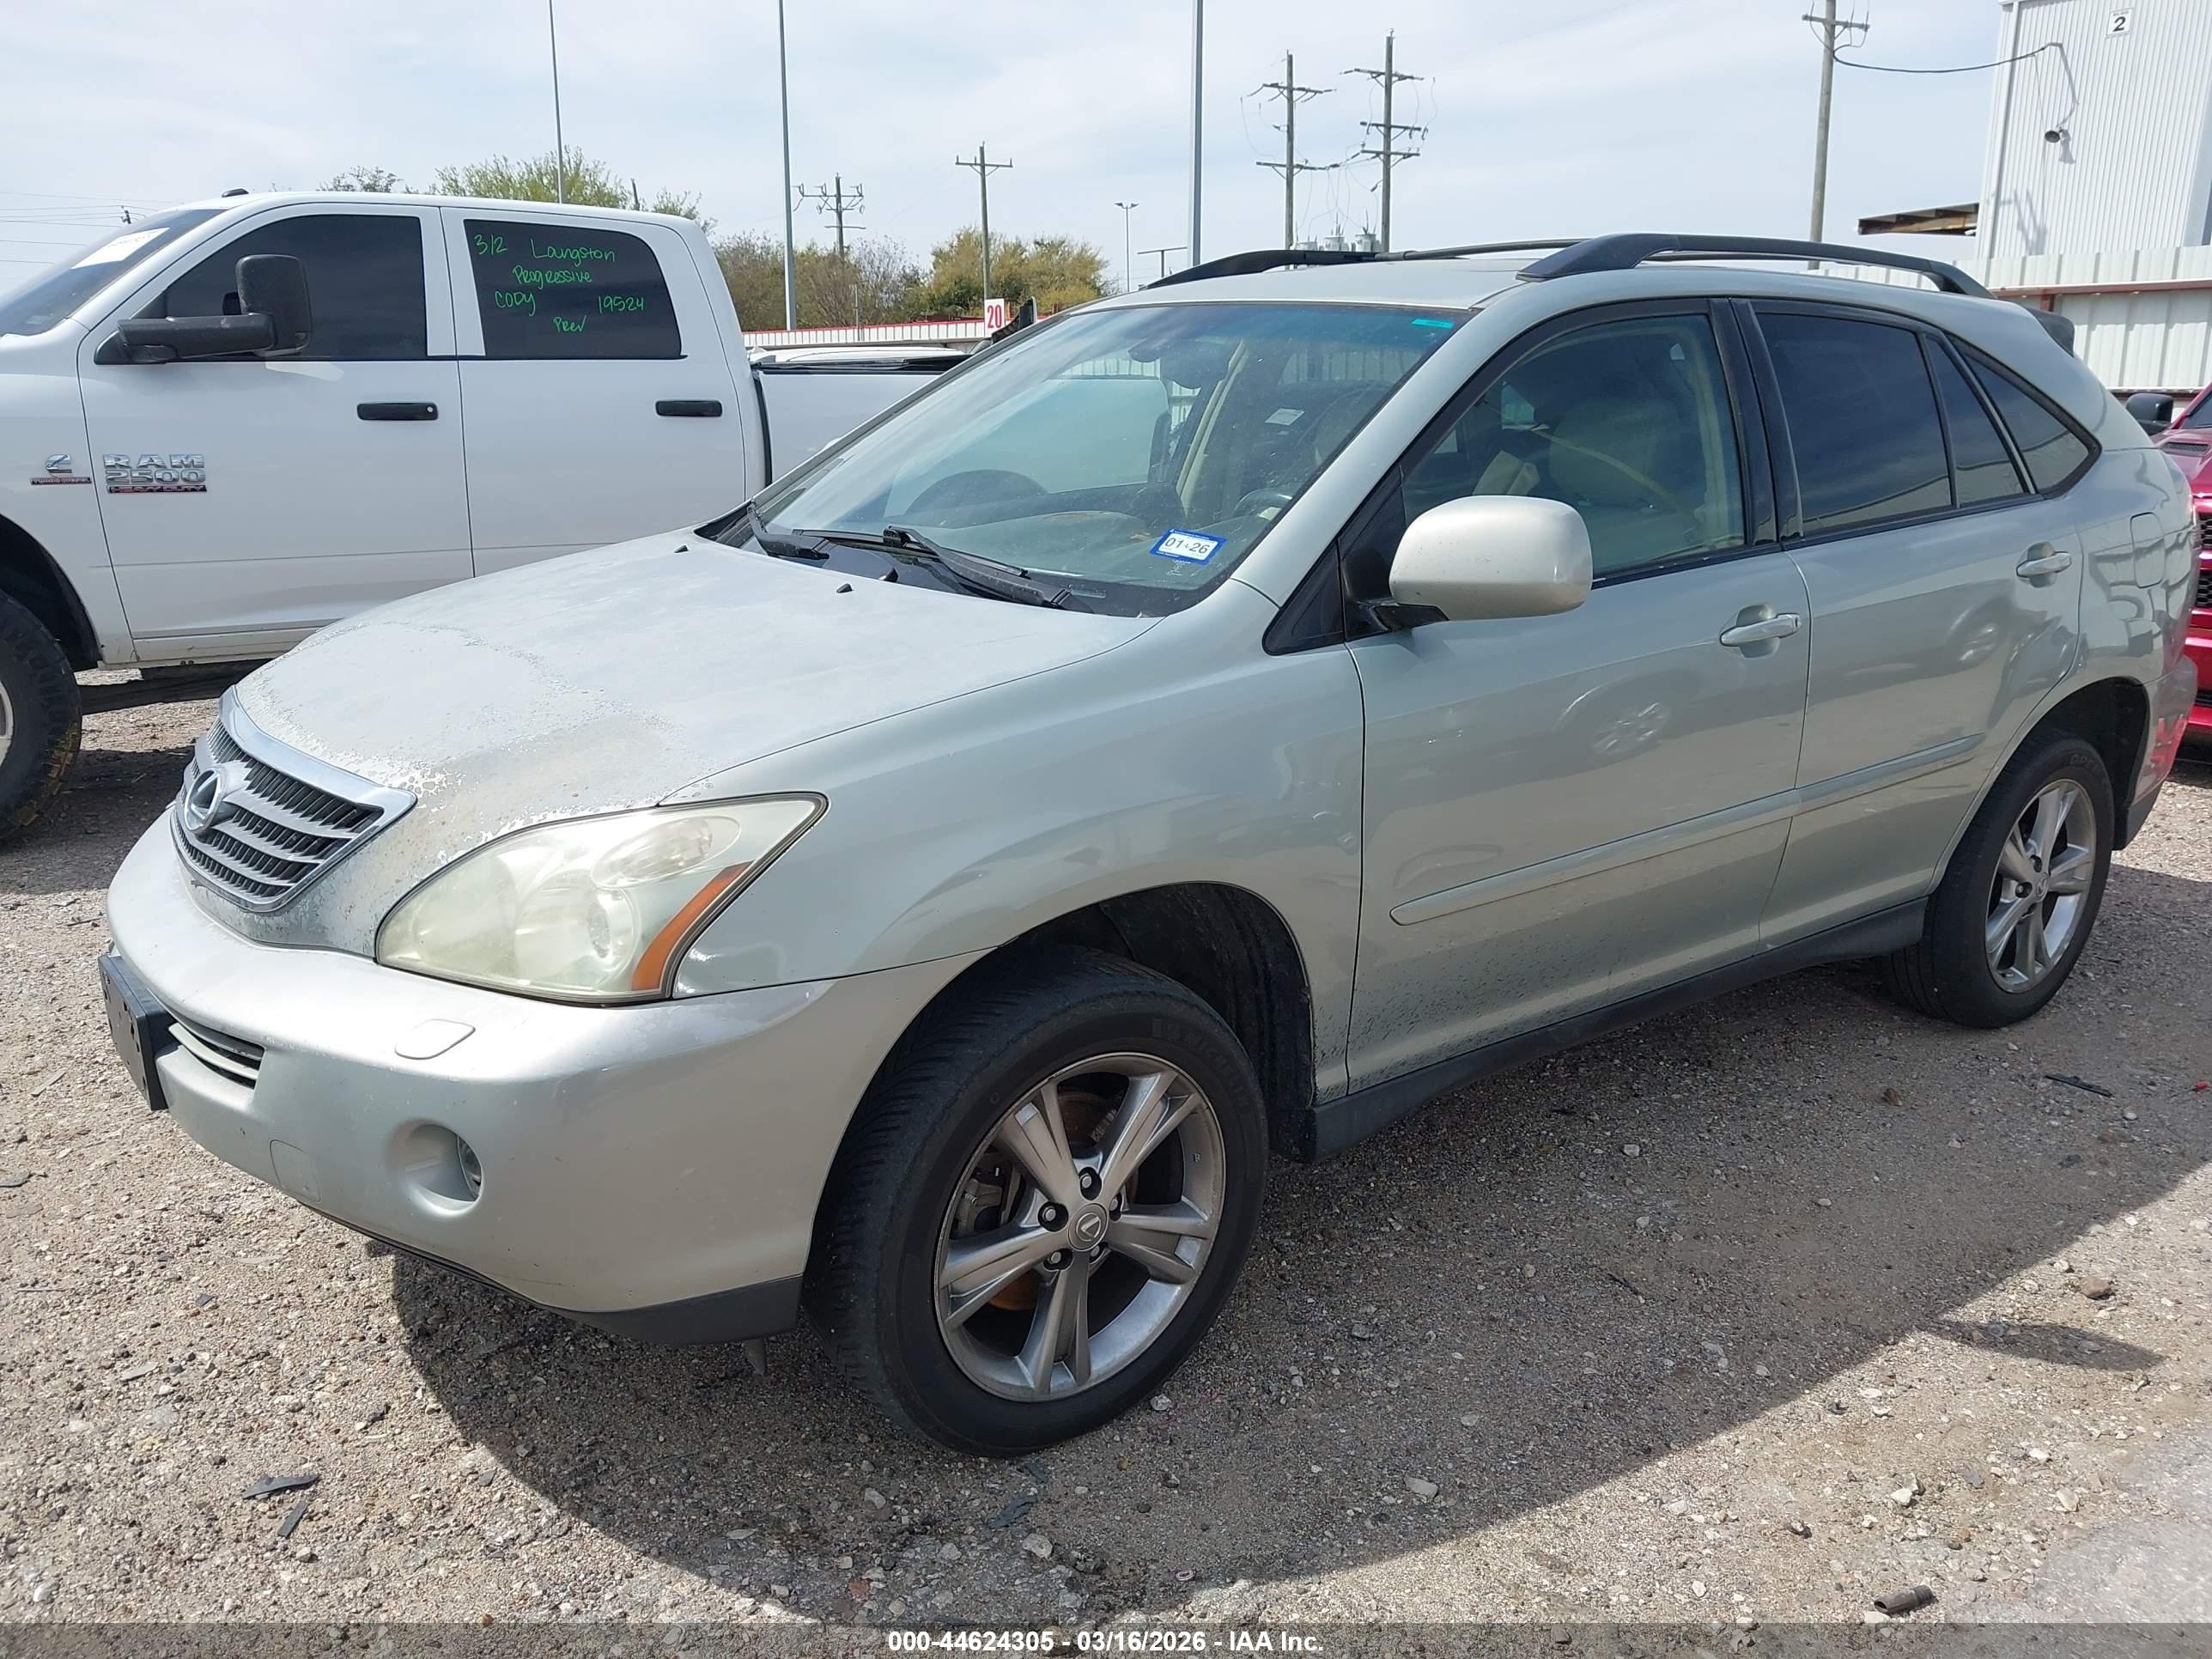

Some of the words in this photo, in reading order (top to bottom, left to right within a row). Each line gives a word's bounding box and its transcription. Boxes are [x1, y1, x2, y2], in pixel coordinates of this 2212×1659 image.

[2113, 16, 2125, 32] 2
[598, 295, 644, 313] 19524
[988, 305, 1002, 328] 20
[103, 454, 205, 469] RAM
[106, 469, 206, 485] 2500
